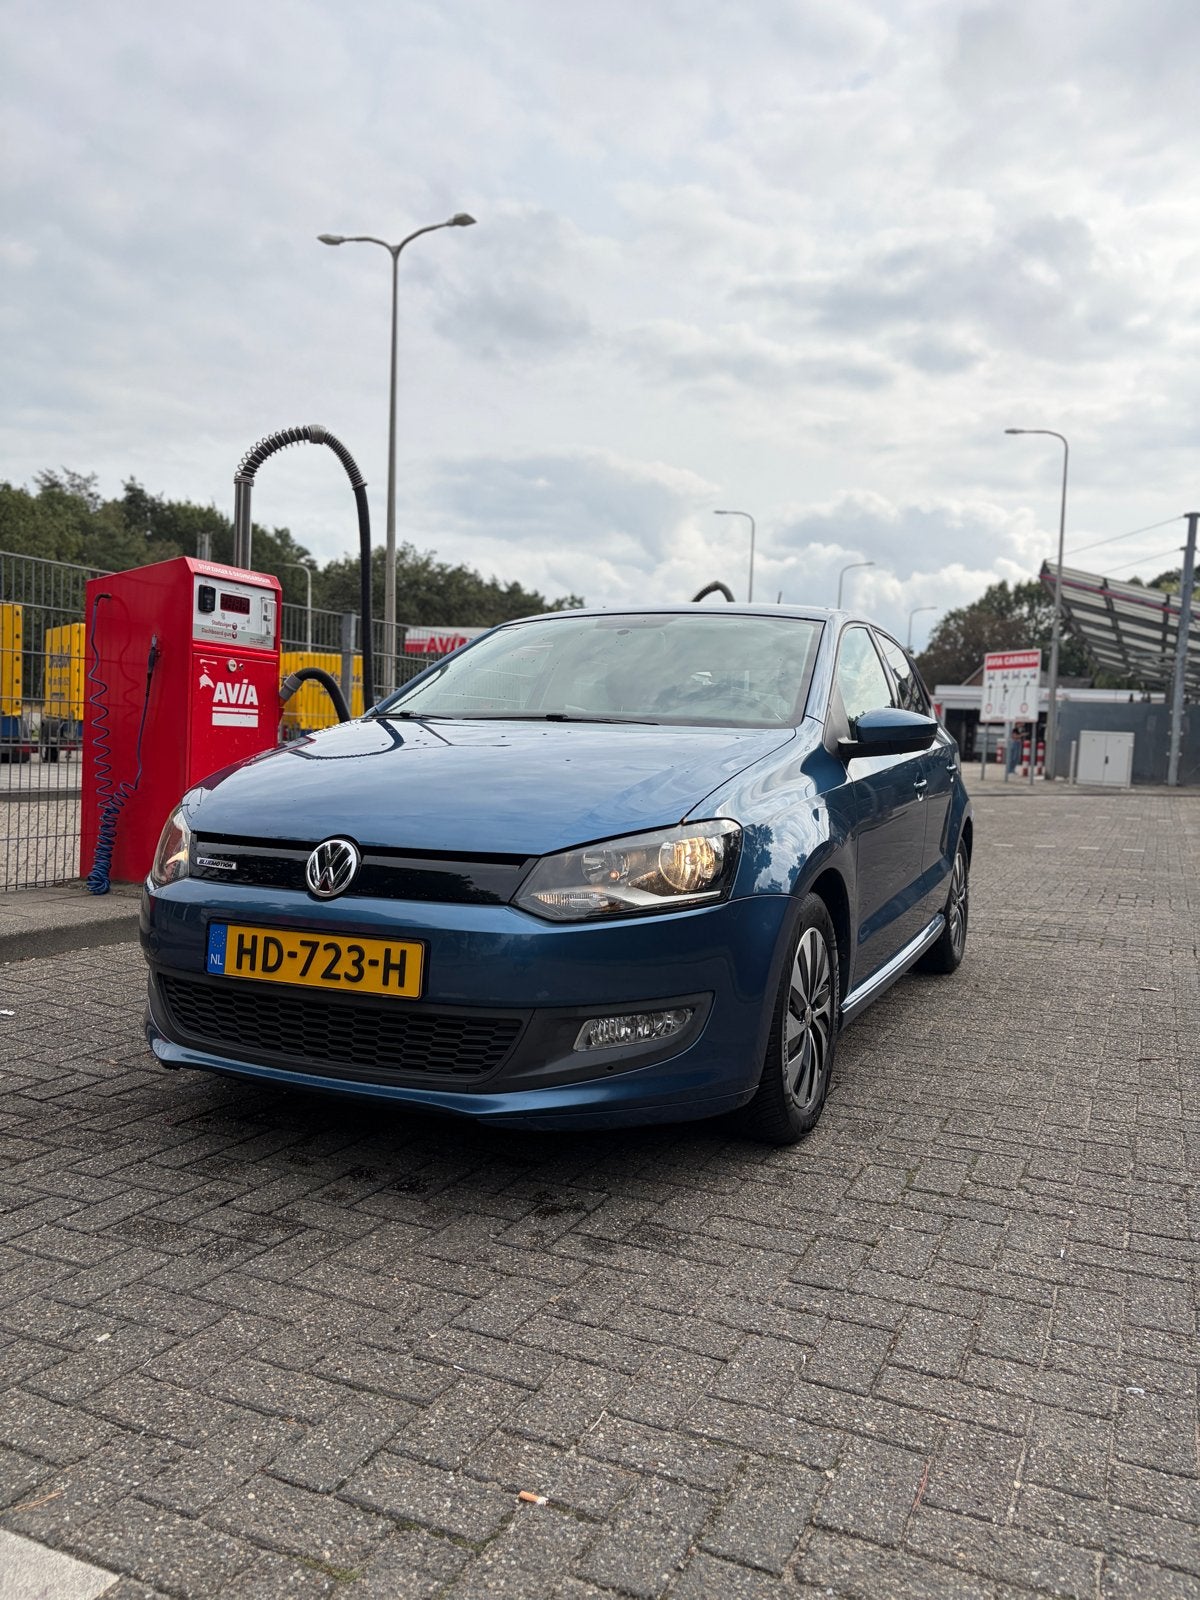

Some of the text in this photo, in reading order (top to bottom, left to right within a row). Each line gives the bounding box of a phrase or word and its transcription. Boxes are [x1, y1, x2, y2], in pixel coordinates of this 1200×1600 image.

[212, 678, 259, 706] AVIA
[199, 859, 234, 868] BLUEMOTION
[210, 953, 223, 966] NL
[235, 933, 407, 988] HD-723-H
